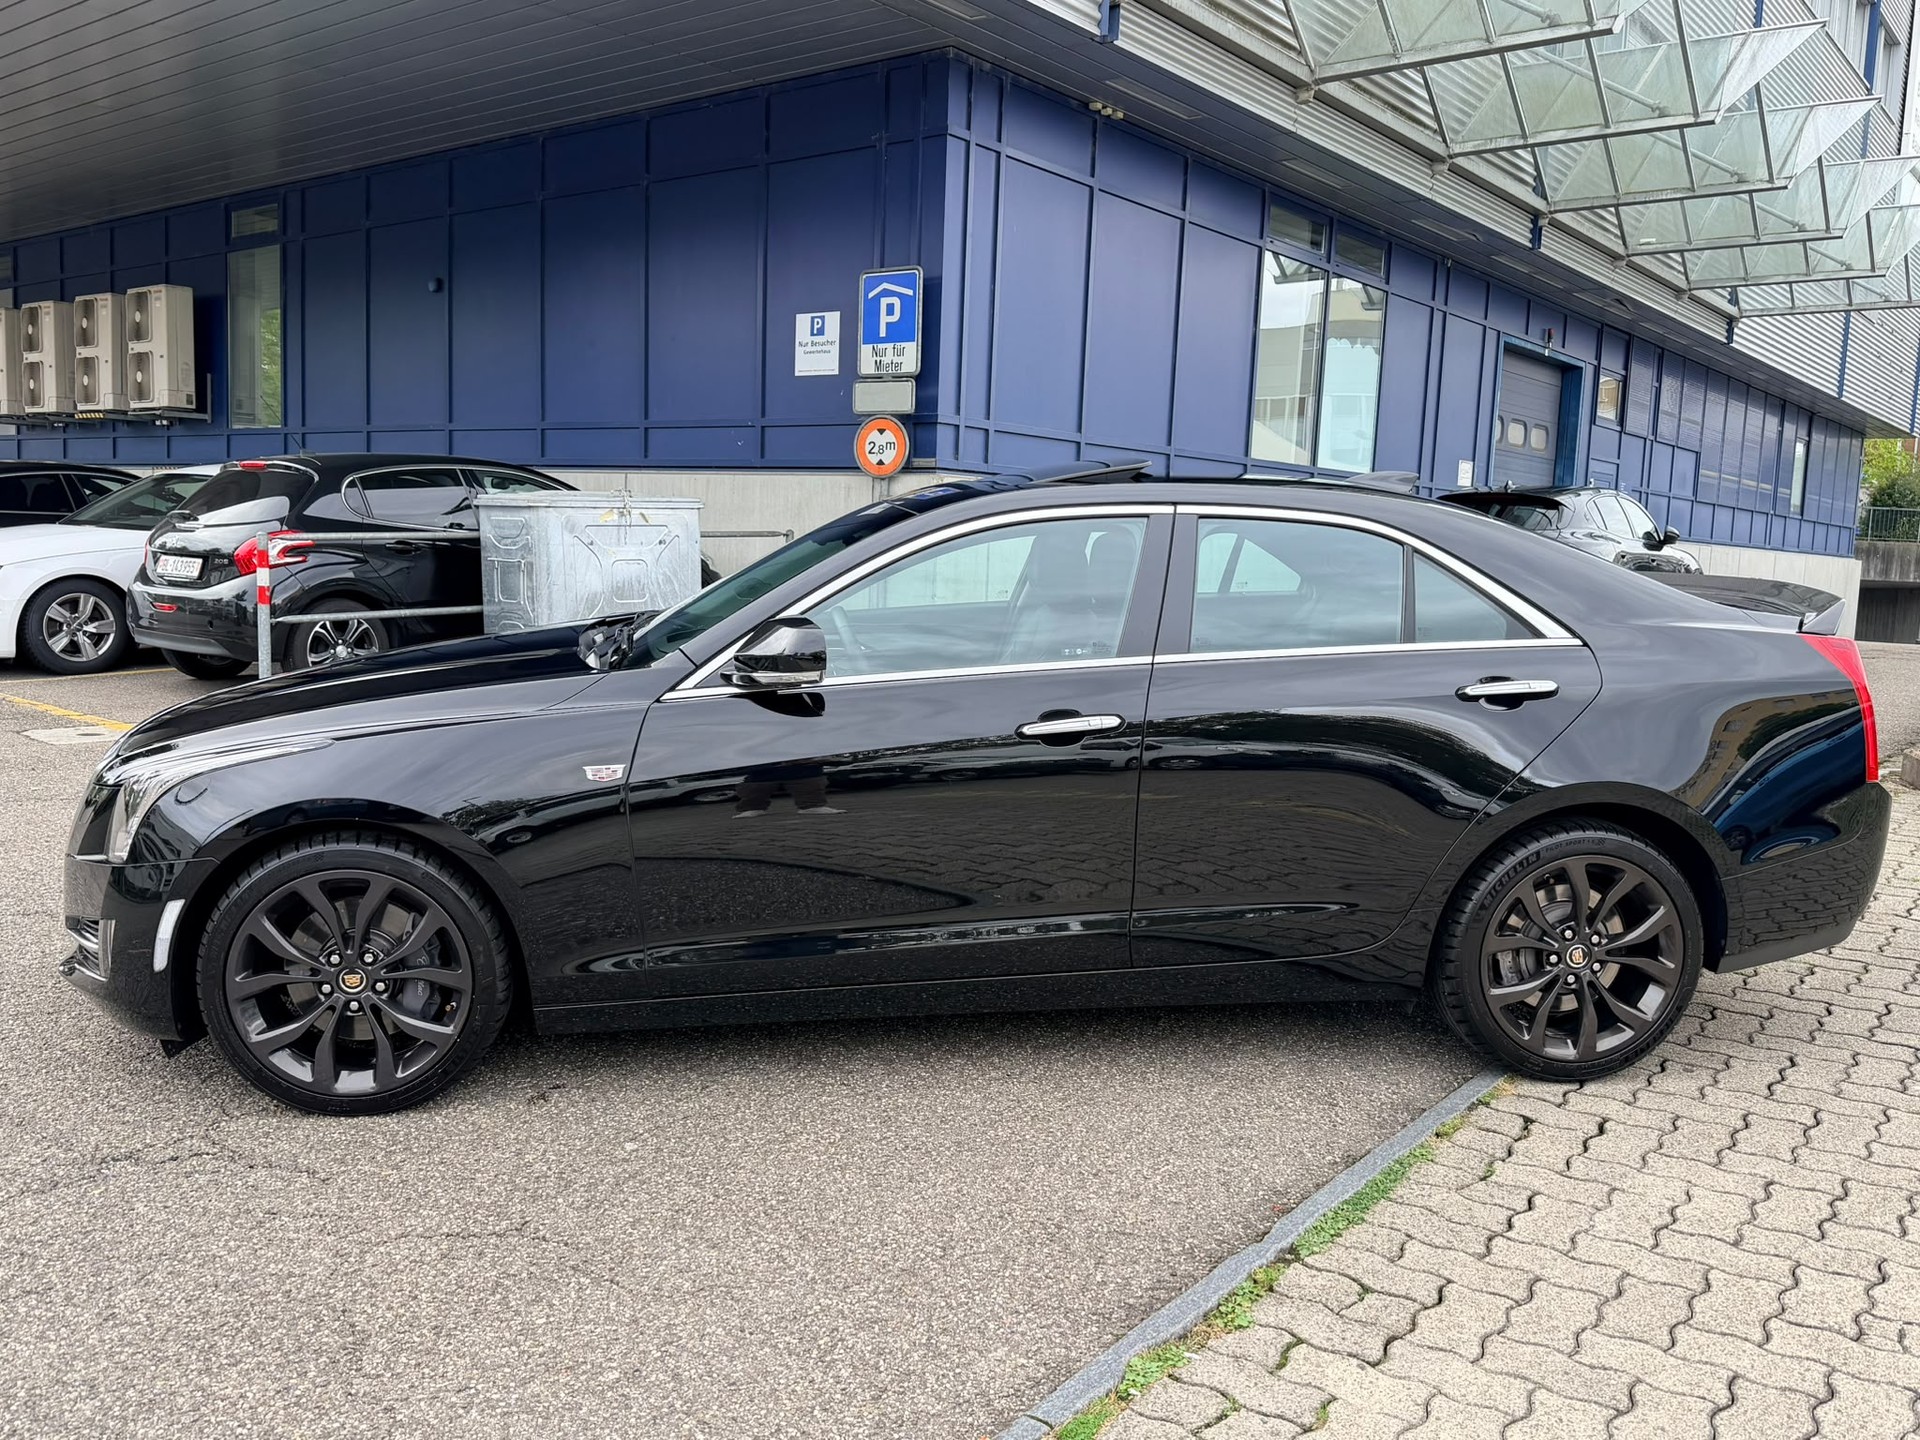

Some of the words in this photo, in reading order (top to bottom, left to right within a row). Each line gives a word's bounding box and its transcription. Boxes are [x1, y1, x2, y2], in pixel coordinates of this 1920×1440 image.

[879, 296, 901, 338] P
[813, 318, 822, 334] P
[798, 340, 809, 348] Nur
[810, 339, 837, 347] Besucher
[871, 344, 888, 358] Nur
[892, 343, 906, 357] für
[874, 359, 904, 372] Mieter
[1482, 853, 1538, 908] MICHELIN
